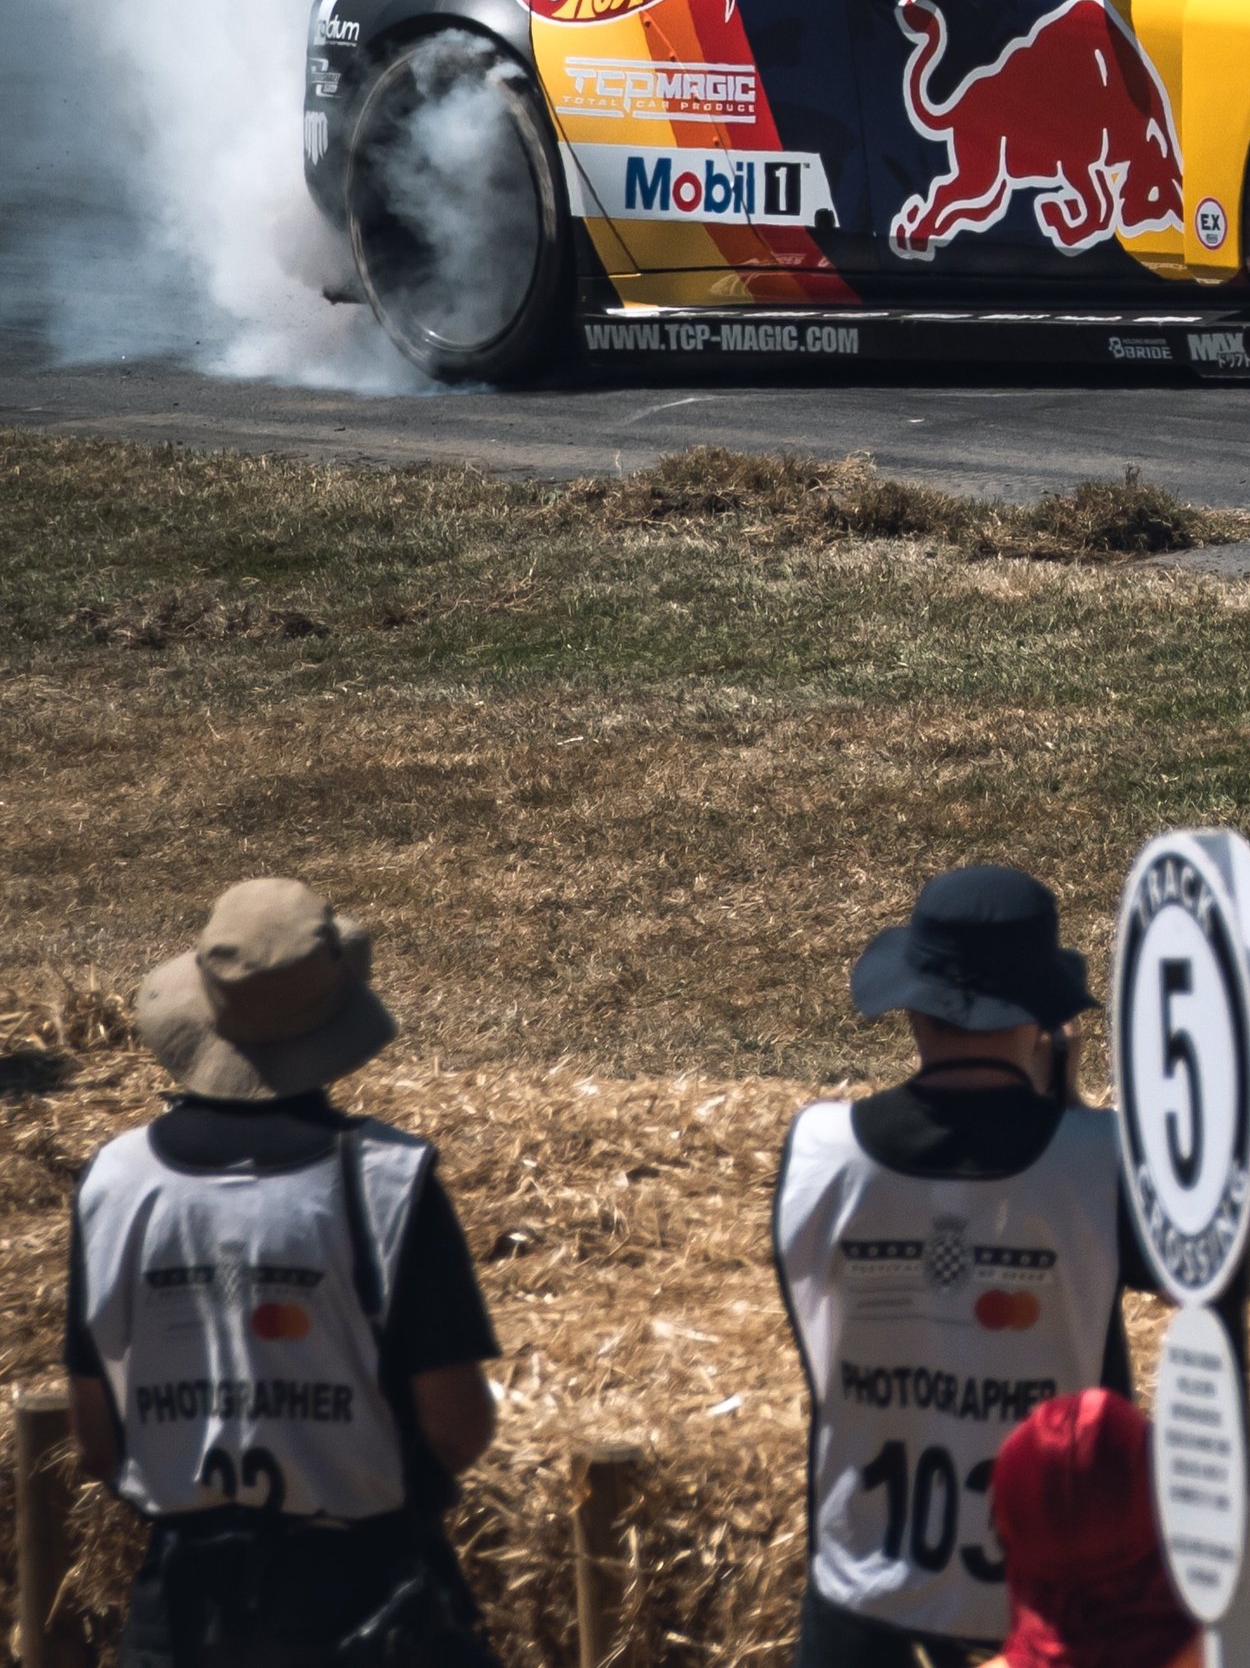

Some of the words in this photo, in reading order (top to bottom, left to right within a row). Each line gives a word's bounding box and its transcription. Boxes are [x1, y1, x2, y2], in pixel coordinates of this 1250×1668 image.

[562, 95, 618, 108] TOTAL
[635, 99, 671, 109] CAR
[680, 102, 756, 114] PRODUCE
[624, 156, 756, 213] Mobil
[1200, 213, 1221, 231] EX
[584, 323, 859, 354] WWW.TCP-MAGIC.COM
[1123, 346, 1173, 359] BRIDE
[1187, 333, 1245, 361] MAX
[1158, 956, 1205, 1192] 5
